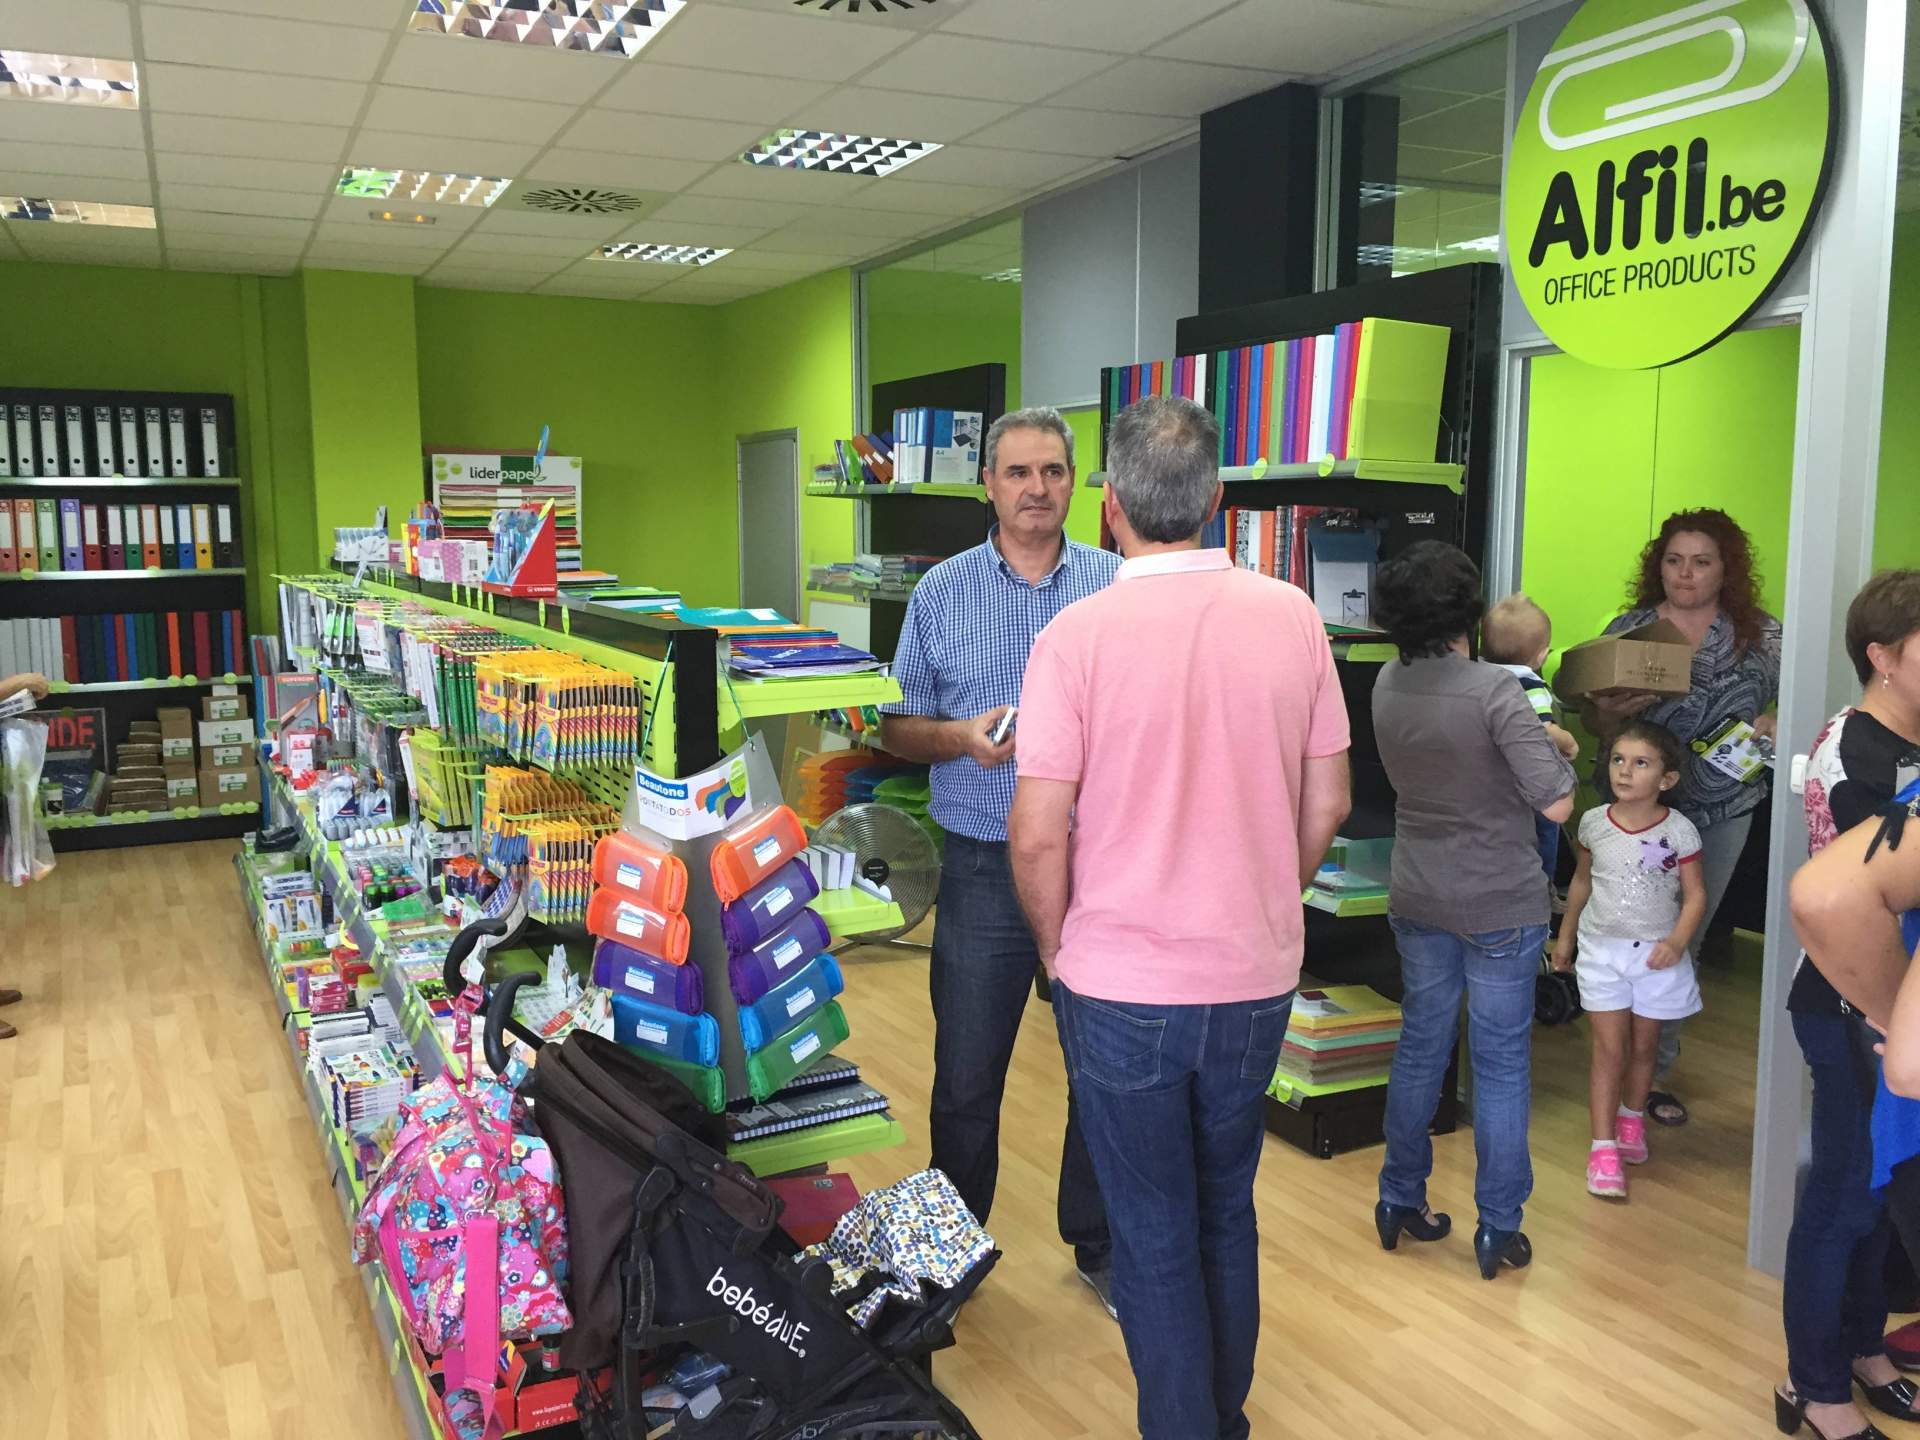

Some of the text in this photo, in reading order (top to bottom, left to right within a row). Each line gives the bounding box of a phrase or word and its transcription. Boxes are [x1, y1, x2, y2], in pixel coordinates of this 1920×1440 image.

[1528, 137, 1786, 268] Alfil.be
[1544, 244, 1756, 305] OFFICE PRODUCTS
[639, 774, 685, 798] Beautone
